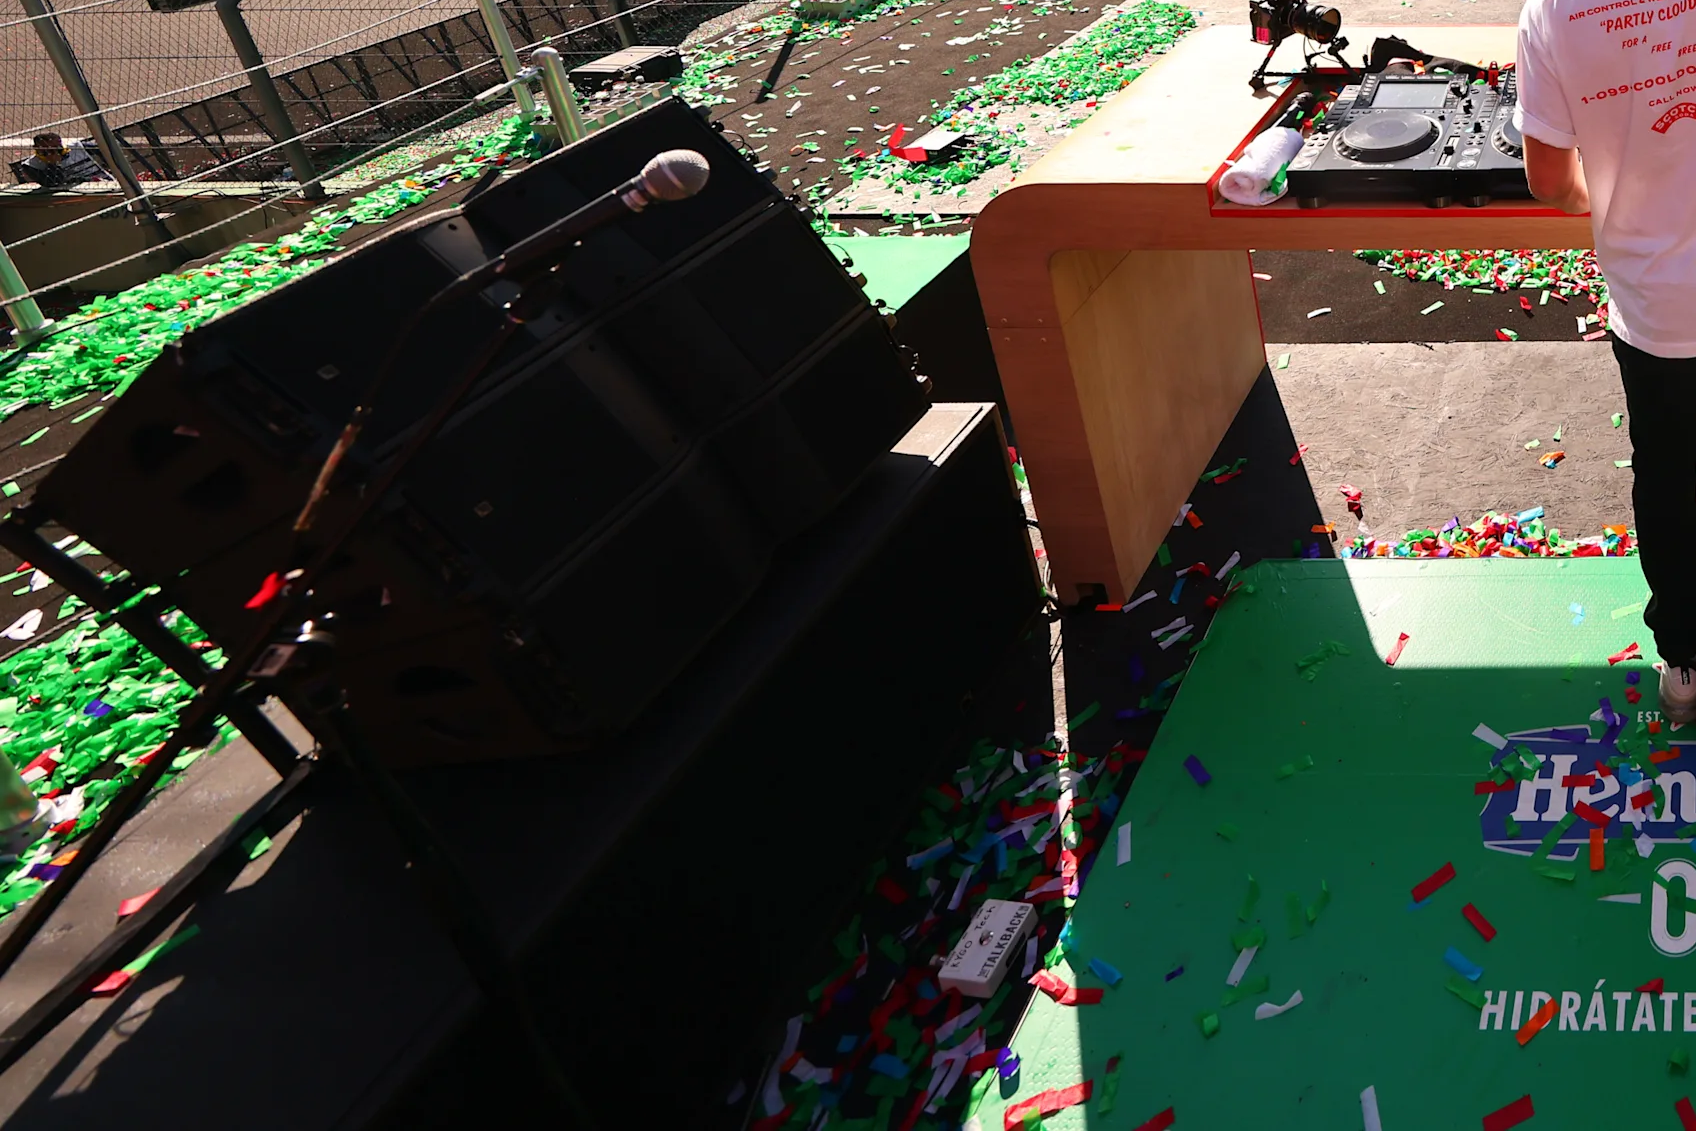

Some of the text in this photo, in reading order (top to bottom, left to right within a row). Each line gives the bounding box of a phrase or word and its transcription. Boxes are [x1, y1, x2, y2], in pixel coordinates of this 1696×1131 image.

[1569, 11, 1585, 22] AIR
[1587, 0, 1637, 15] CONTROL
[1622, 38, 1638, 49] FOR
[1641, 35, 1647, 44] A
[1651, 41, 1672, 54] FREE
[1648, 95, 1674, 107] CALL
[1637, 711, 1664, 723] EST.
[984, 912, 1027, 968] TALKBACK
[950, 940, 973, 968] KYGO
